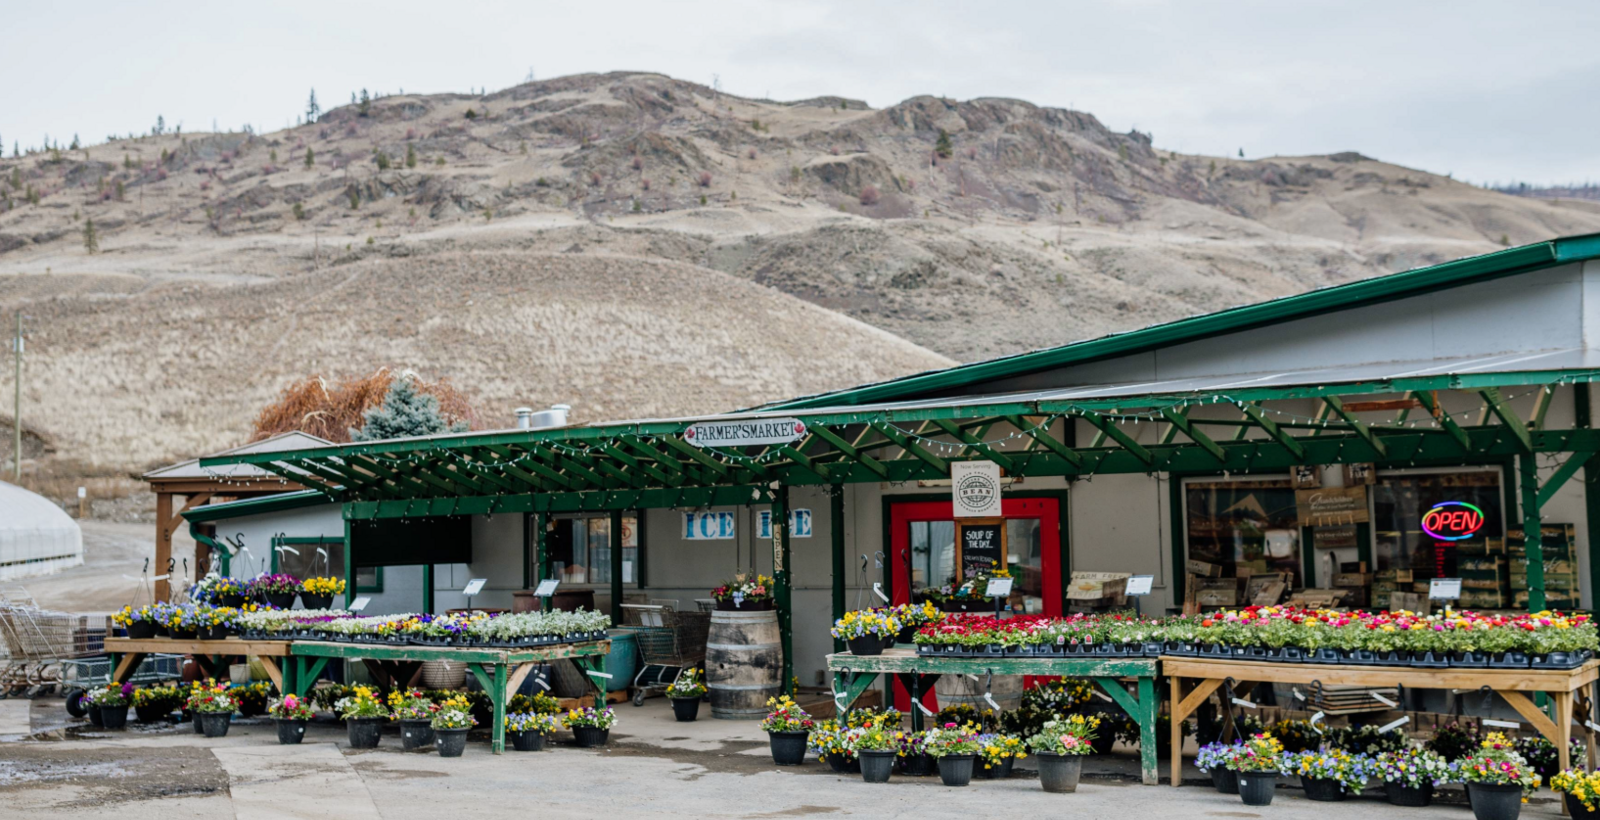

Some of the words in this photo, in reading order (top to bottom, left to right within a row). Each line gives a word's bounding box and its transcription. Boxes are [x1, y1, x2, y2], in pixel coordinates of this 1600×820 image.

[962, 488, 991, 496] BEAN
[685, 511, 734, 538] ICE
[760, 510, 811, 537] IE
[1425, 511, 1478, 531] OPEN
[965, 530, 984, 541] SOUP
[985, 530, 994, 540] OF
[968, 540, 979, 549] THE
[774, 531, 782, 569] OPEN
